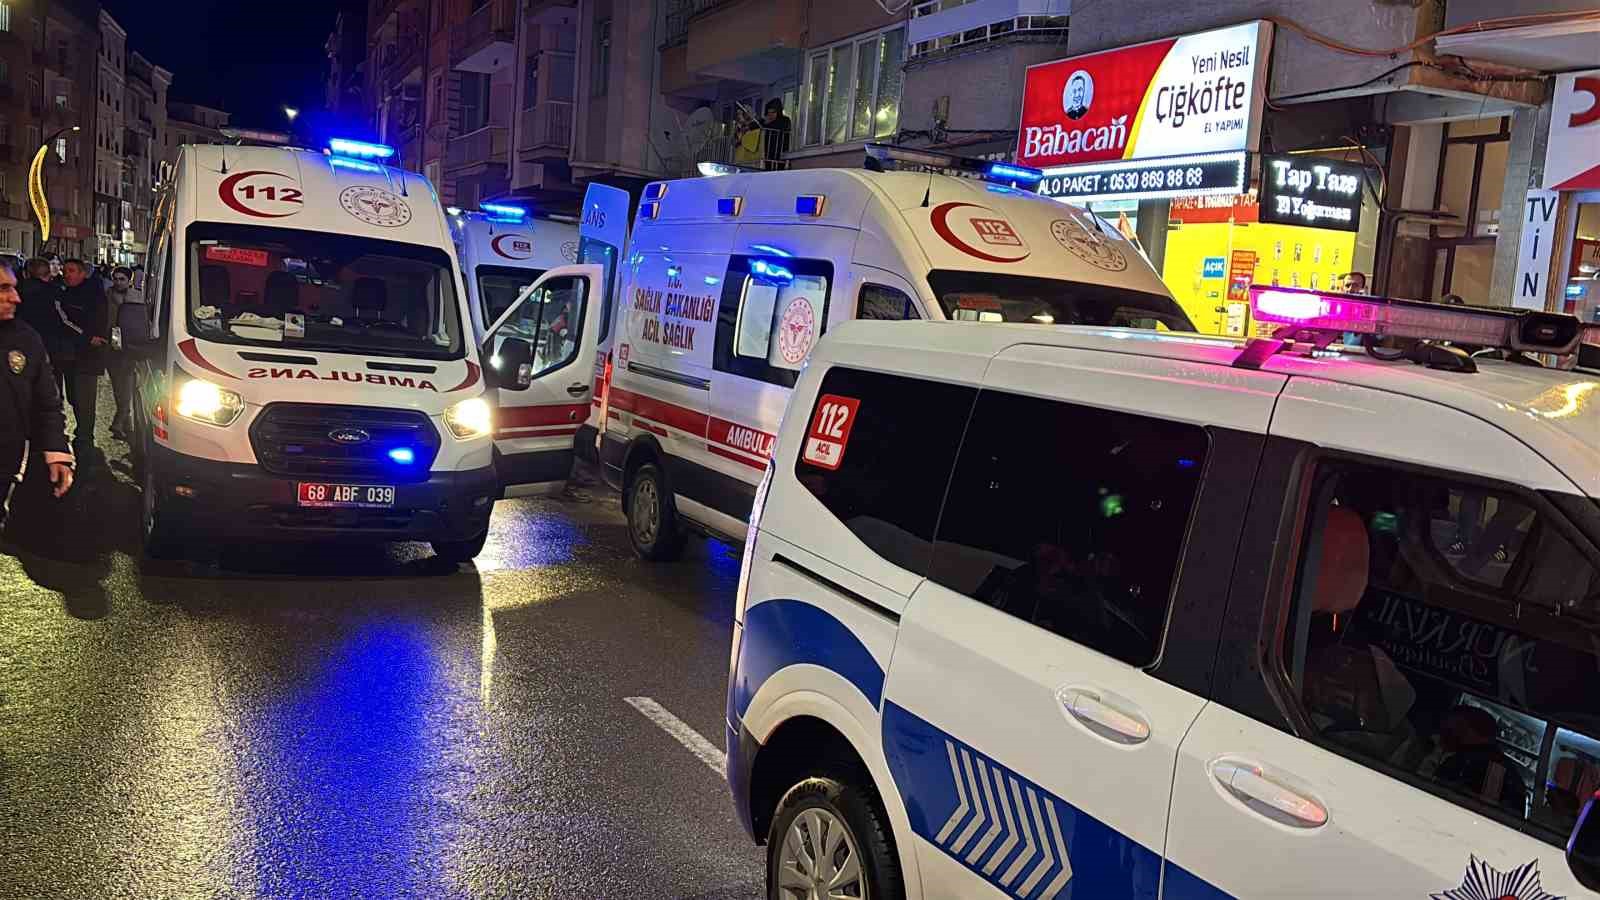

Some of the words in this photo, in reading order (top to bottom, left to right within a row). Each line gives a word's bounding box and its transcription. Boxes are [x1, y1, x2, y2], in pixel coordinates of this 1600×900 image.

[1191, 55, 1217, 75] Yeni
[1220, 46, 1250, 70] Nesil
[1155, 76, 1246, 128] Çiğköfte
[1203, 125, 1213, 134] EL
[1214, 118, 1244, 133] YAPIMI
[1039, 178, 1061, 195] ALO
[1062, 174, 1099, 193] PAKET
[1109, 171, 1139, 190] 0530
[1141, 169, 1164, 189] 869
[1165, 168, 1183, 187] 88
[1185, 167, 1204, 186] 68
[1272, 160, 1312, 193] Tap
[238, 185, 304, 204] 112
[1527, 197, 1556, 222] TV
[976, 221, 1009, 234] 112
[1204, 261, 1223, 274] AÇIK
[634, 286, 663, 313] SAĞLIK
[664, 291, 716, 324] BAKANLIĞI
[642, 318, 660, 343] ACİL
[662, 319, 696, 350] SAĞLIK
[817, 402, 849, 439] 112
[308, 485, 325, 500] 68
[333, 486, 359, 502] ABF
[367, 488, 393, 503] 039
